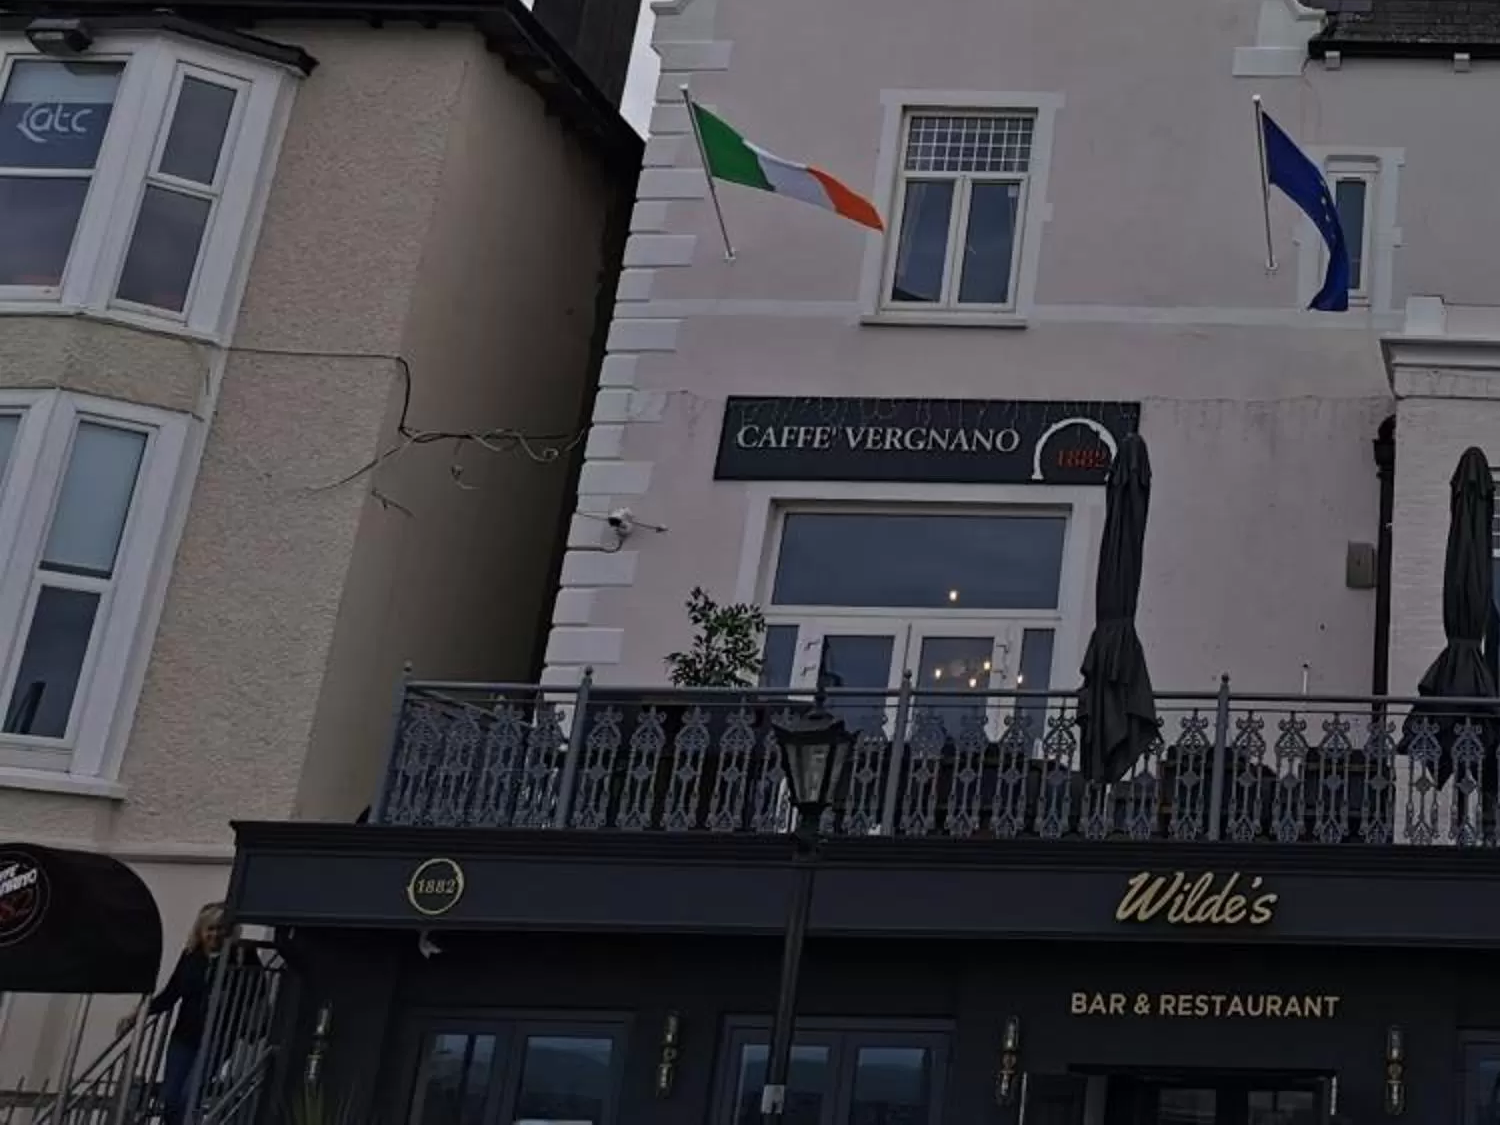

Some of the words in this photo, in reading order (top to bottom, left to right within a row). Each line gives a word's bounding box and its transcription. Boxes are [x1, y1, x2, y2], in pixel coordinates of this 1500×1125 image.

[848, 426, 1020, 453] VERGNANO
[416, 878, 456, 894] 1882
[1115, 871, 1278, 925] Wilde's
[1071, 992, 1127, 1015] BAR
[1133, 993, 1150, 1016] &
[1159, 994, 1340, 1018] RESTAURANT
